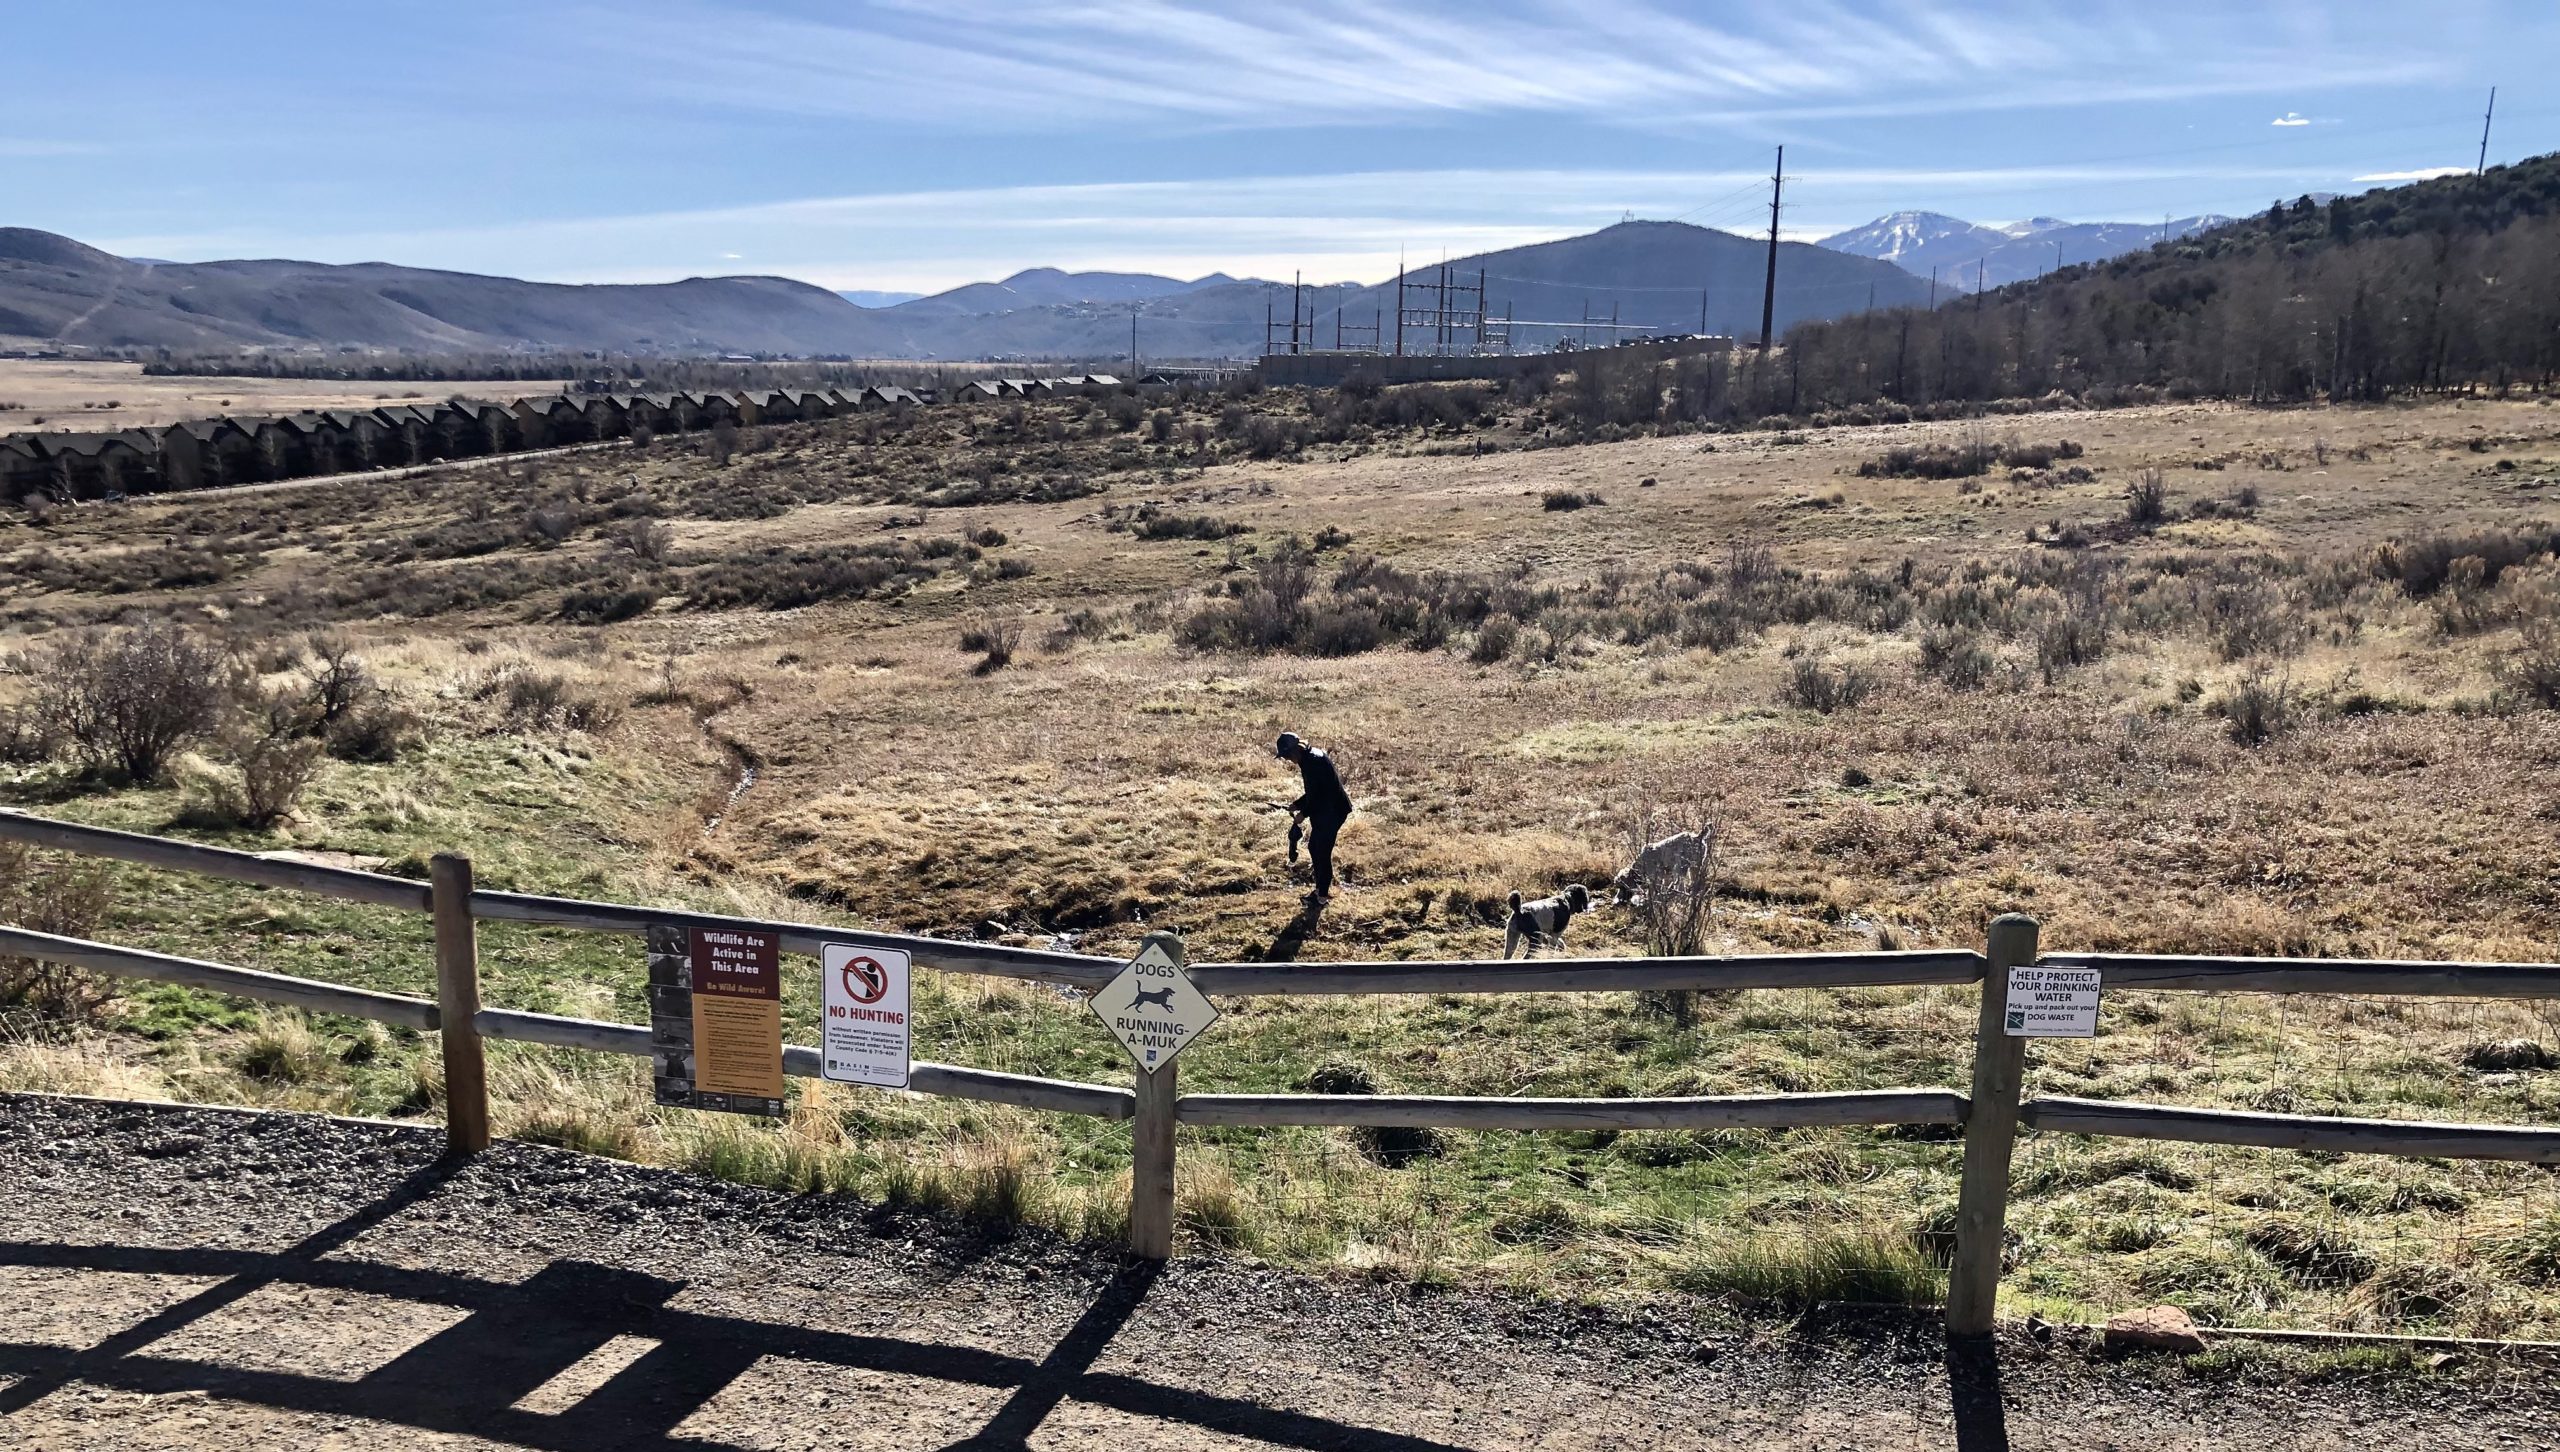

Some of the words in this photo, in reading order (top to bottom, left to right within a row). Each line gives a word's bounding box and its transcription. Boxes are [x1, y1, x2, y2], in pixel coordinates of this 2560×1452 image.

[704, 932, 744, 945] Wildlife
[746, 936, 765, 947] Are
[713, 947, 744, 959] Active
[746, 949, 757, 960] in
[711, 961, 732, 972] This
[735, 963, 759, 974] Area
[1135, 963, 1175, 978] DOGS
[2016, 971, 2044, 981] HELP
[2047, 972, 2096, 982] PROTECT
[706, 982, 717, 990] Be
[718, 983, 736, 992] Wild
[738, 985, 766, 994] Aware!
[2010, 981, 2041, 991] YOUR
[2044, 982, 2099, 992] DRINKING
[2035, 992, 2073, 1002] WATER
[2049, 1003, 2065, 1011] pack
[829, 1005, 846, 1018] NO
[850, 1007, 904, 1025] HUNTING
[2027, 1013, 2046, 1021] DOG
[2047, 1013, 2075, 1021] WASTE
[1116, 1017, 1190, 1036] RUNNING-
[837, 1039, 866, 1047] prosecuted
[870, 1036, 894, 1044] Violators
[1126, 1033, 1177, 1049] A-MUK
[840, 1061, 870, 1069] BASIN
